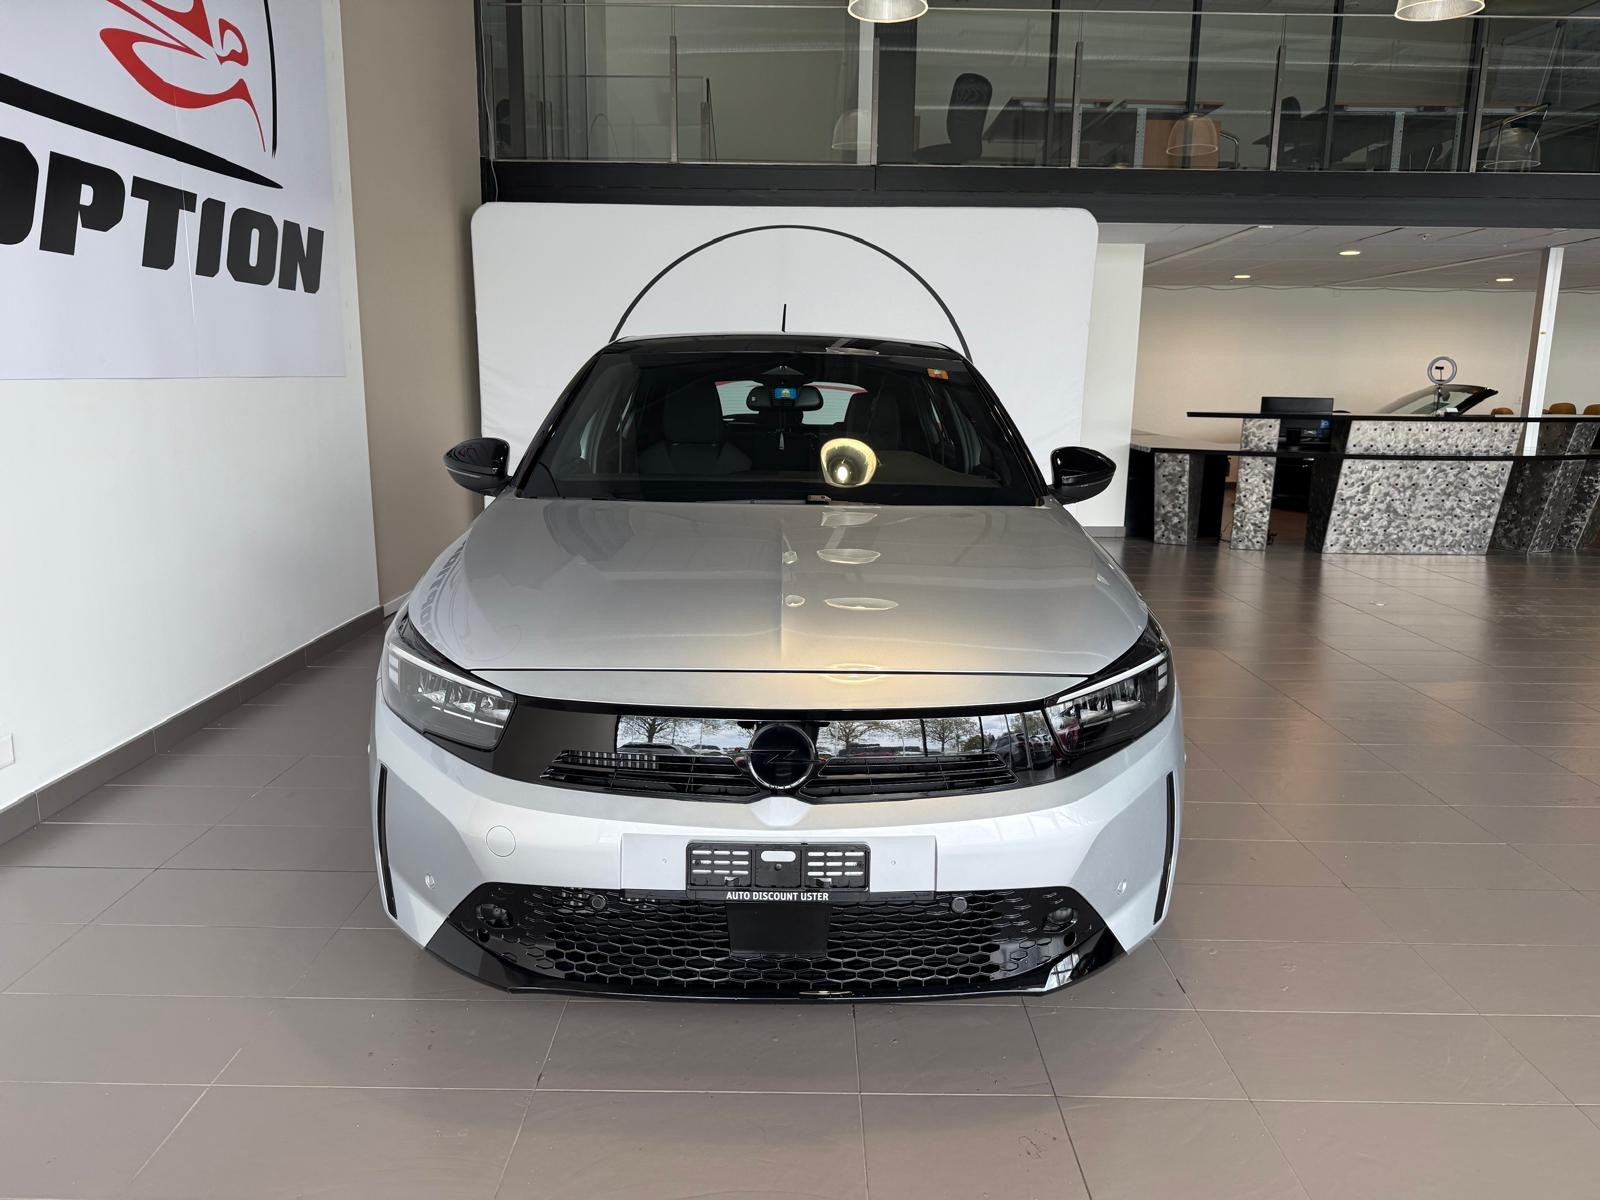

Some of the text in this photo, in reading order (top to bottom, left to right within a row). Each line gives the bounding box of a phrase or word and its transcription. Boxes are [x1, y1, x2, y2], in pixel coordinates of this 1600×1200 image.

[726, 891, 829, 901] AUTO DISCOUNT USTER
